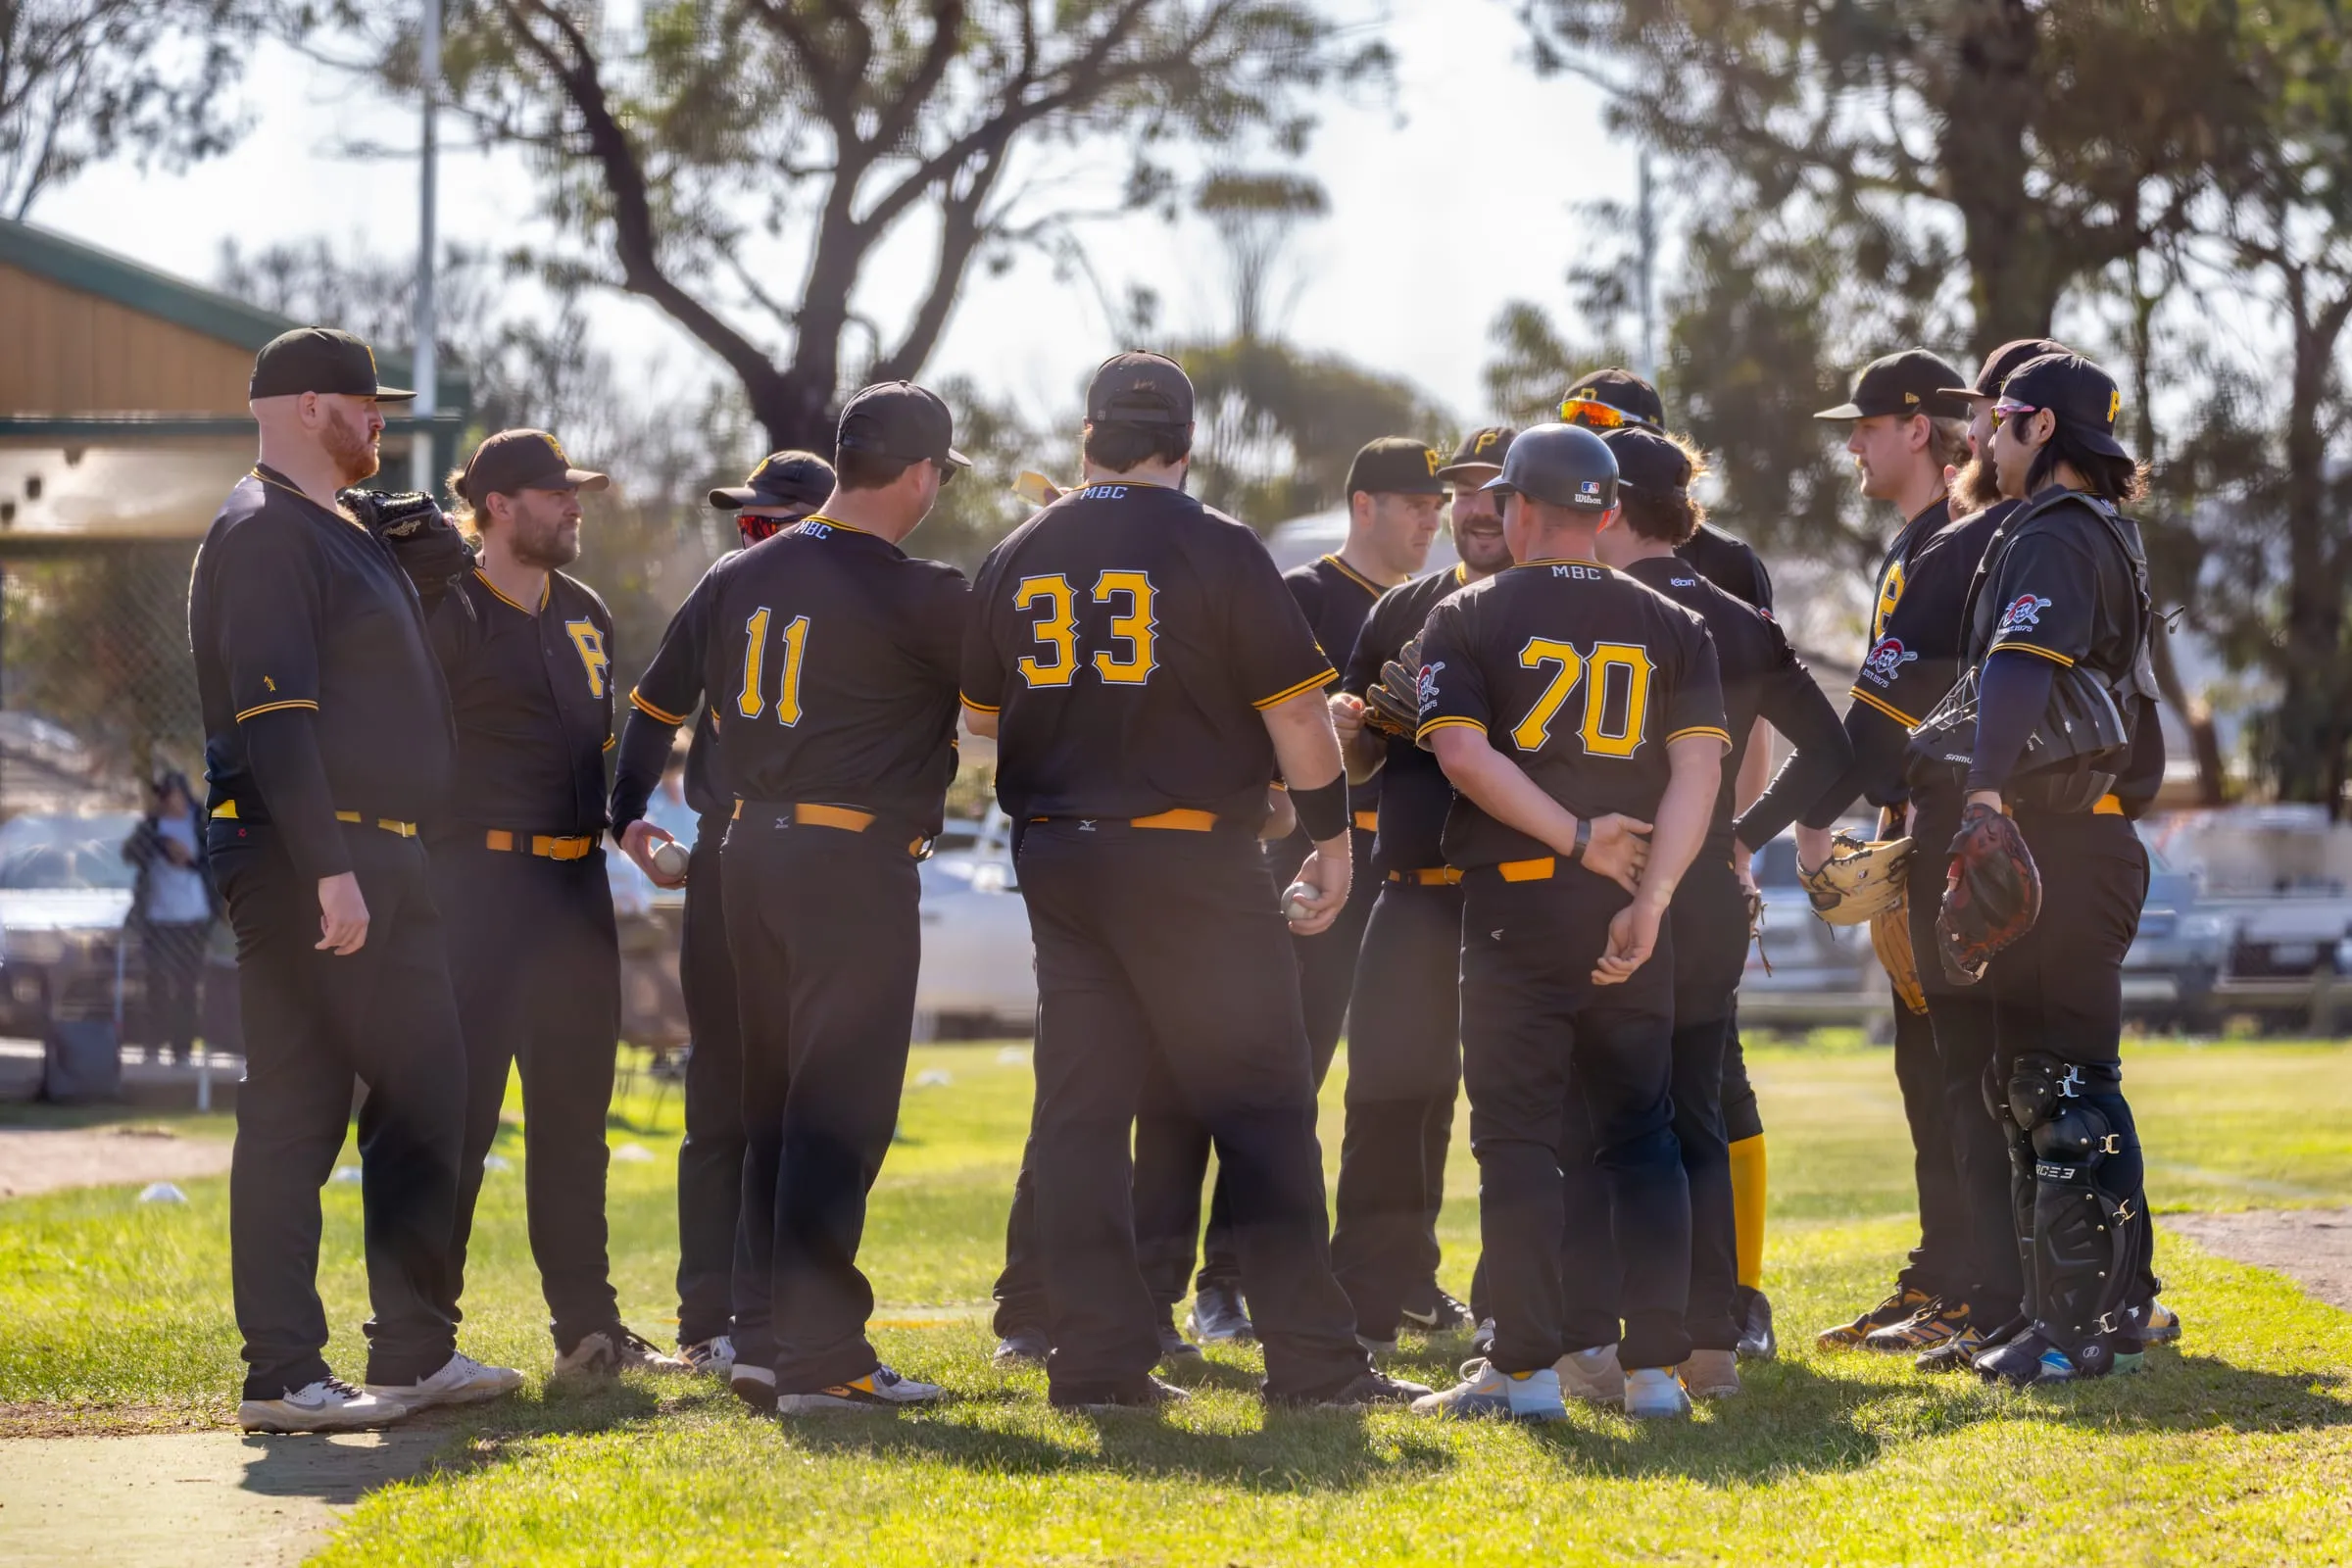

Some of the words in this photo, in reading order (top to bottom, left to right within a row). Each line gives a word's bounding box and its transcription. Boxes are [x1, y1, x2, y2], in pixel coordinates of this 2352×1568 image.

[1475, 432, 1497, 455] P
[1424, 449, 1439, 478] P
[1080, 486, 1129, 500] MBC
[1574, 493, 1602, 505] Wilson
[794, 520, 833, 540] MBC
[1551, 564, 1602, 580] MBC
[1012, 568, 1160, 689] 33
[564, 614, 611, 700] P
[737, 606, 810, 728] 11
[1510, 636, 1658, 760] 70
